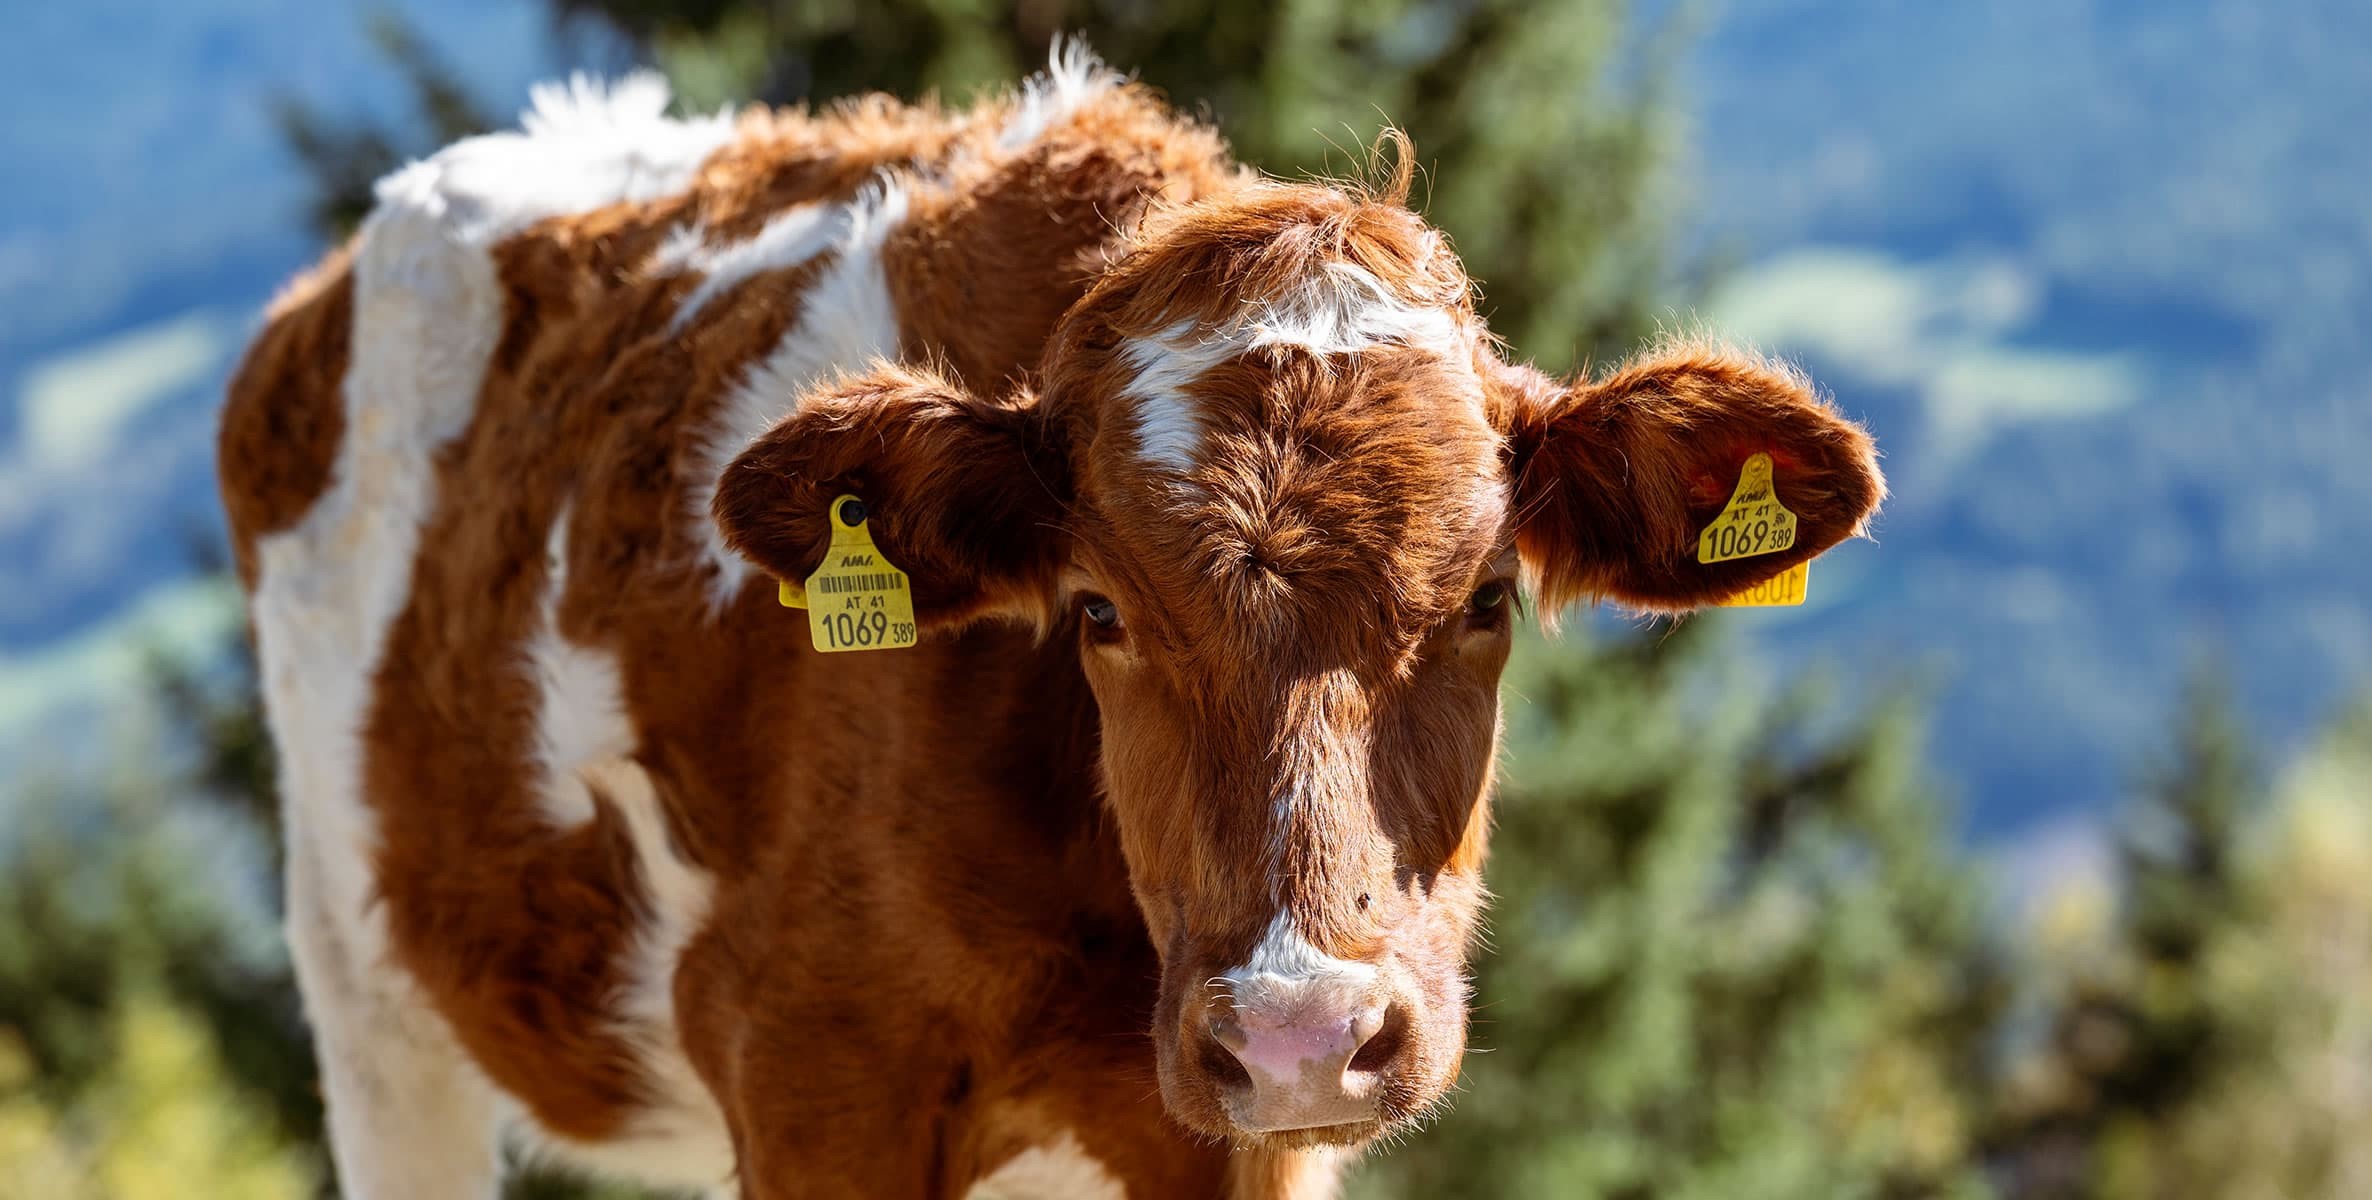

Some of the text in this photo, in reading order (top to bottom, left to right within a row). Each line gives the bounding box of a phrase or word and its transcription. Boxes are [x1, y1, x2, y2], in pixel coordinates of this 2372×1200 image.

[1732, 505, 1769, 521] AT 41
[1707, 520, 1792, 560] 1069 389
[846, 596, 885, 609] AT 41
[821, 610, 915, 648] 1069 389
